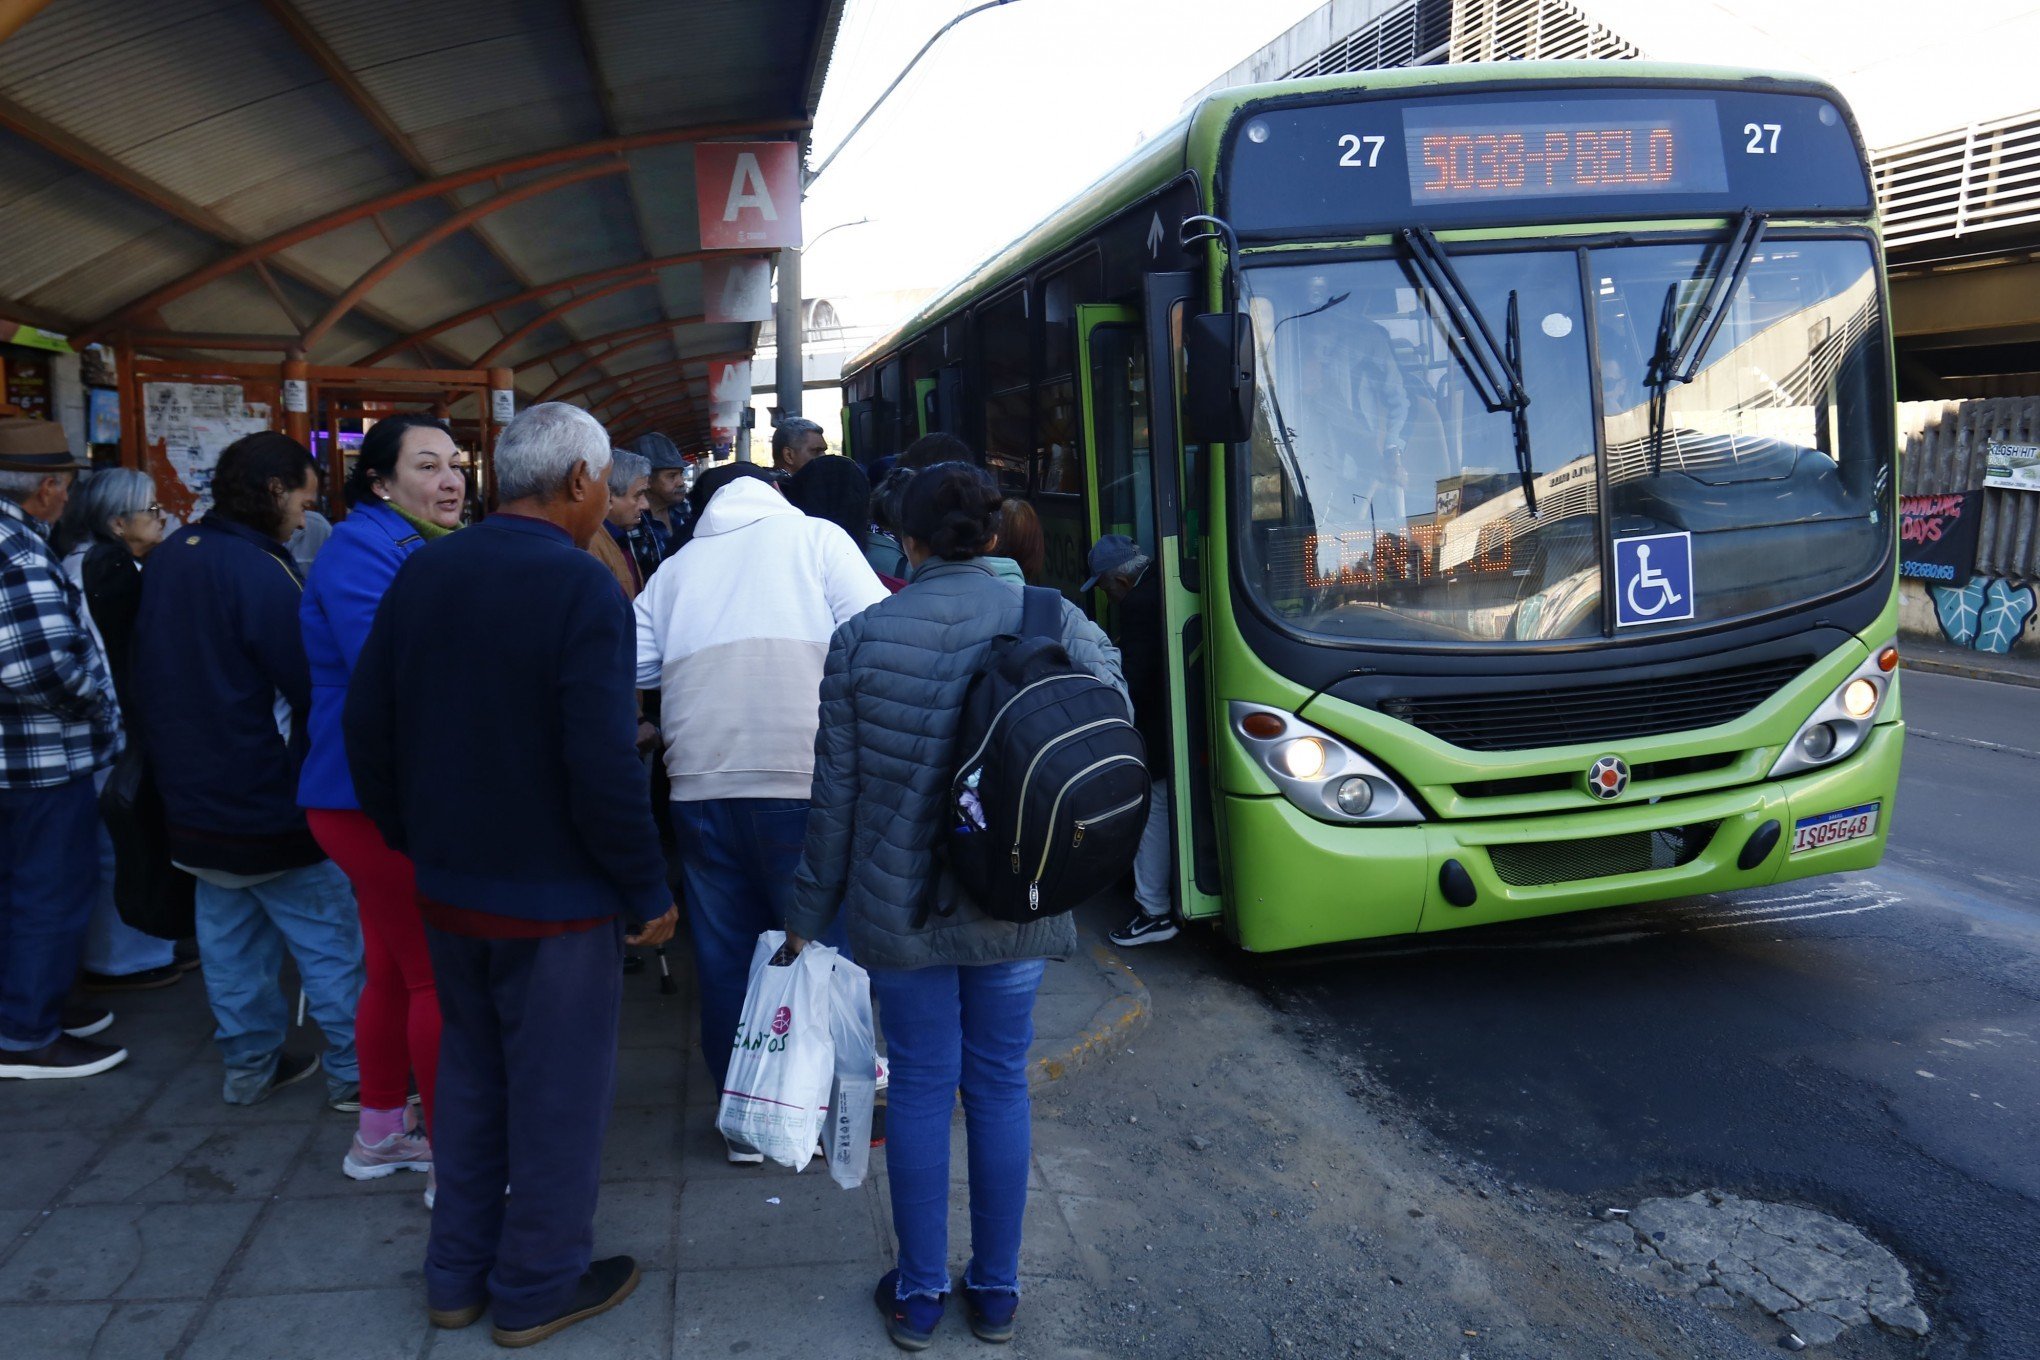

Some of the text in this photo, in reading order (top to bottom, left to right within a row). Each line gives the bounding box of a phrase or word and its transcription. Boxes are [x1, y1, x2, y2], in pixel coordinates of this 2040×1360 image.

[1338, 134, 1386, 168] 27
[1744, 123, 1782, 154] 27
[722, 153, 778, 221] A
[1901, 516, 1942, 544] DAYS
